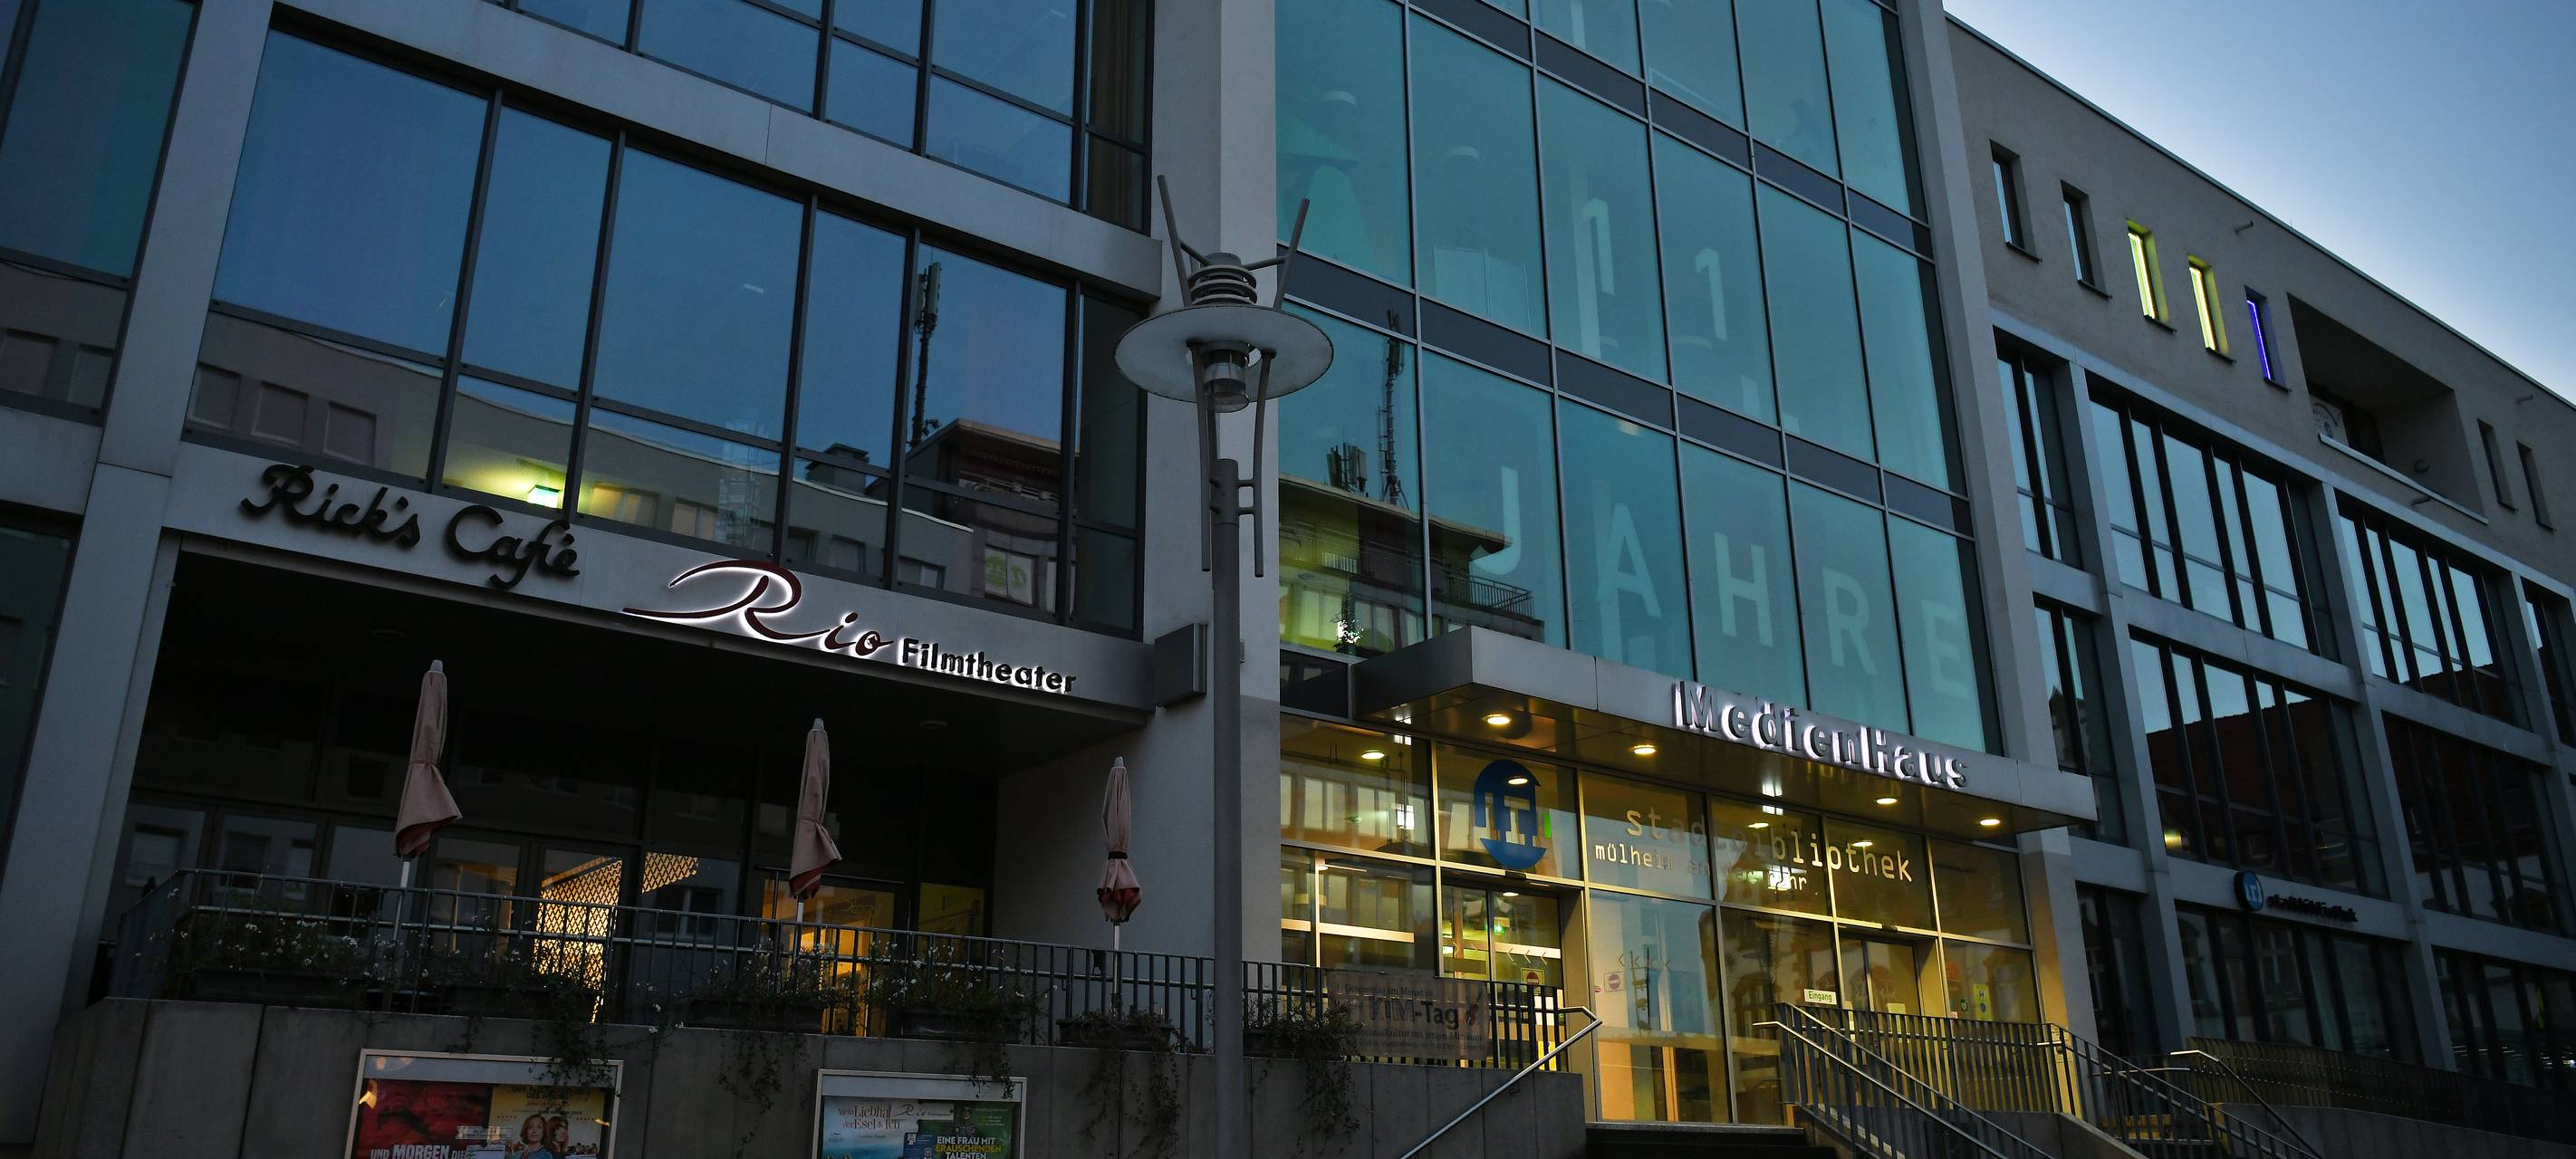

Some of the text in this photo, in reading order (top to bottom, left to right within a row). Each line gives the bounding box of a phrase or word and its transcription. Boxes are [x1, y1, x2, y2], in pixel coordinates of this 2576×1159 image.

[241, 464, 420, 548] Rick's
[1469, 465, 1971, 702] JAHRE
[622, 559, 1077, 694] Rio Filmtheater
[1674, 680, 1968, 790] MedienHaus
[1769, 869, 1807, 891] rhr
[1808, 991, 1832, 1001] Eingang
[392, 1144, 450, 1159] MORGEN
[935, 1145, 1002, 1153] ERAUSCHENDEN
[937, 1136, 996, 1145] EINE FRAU MIT
